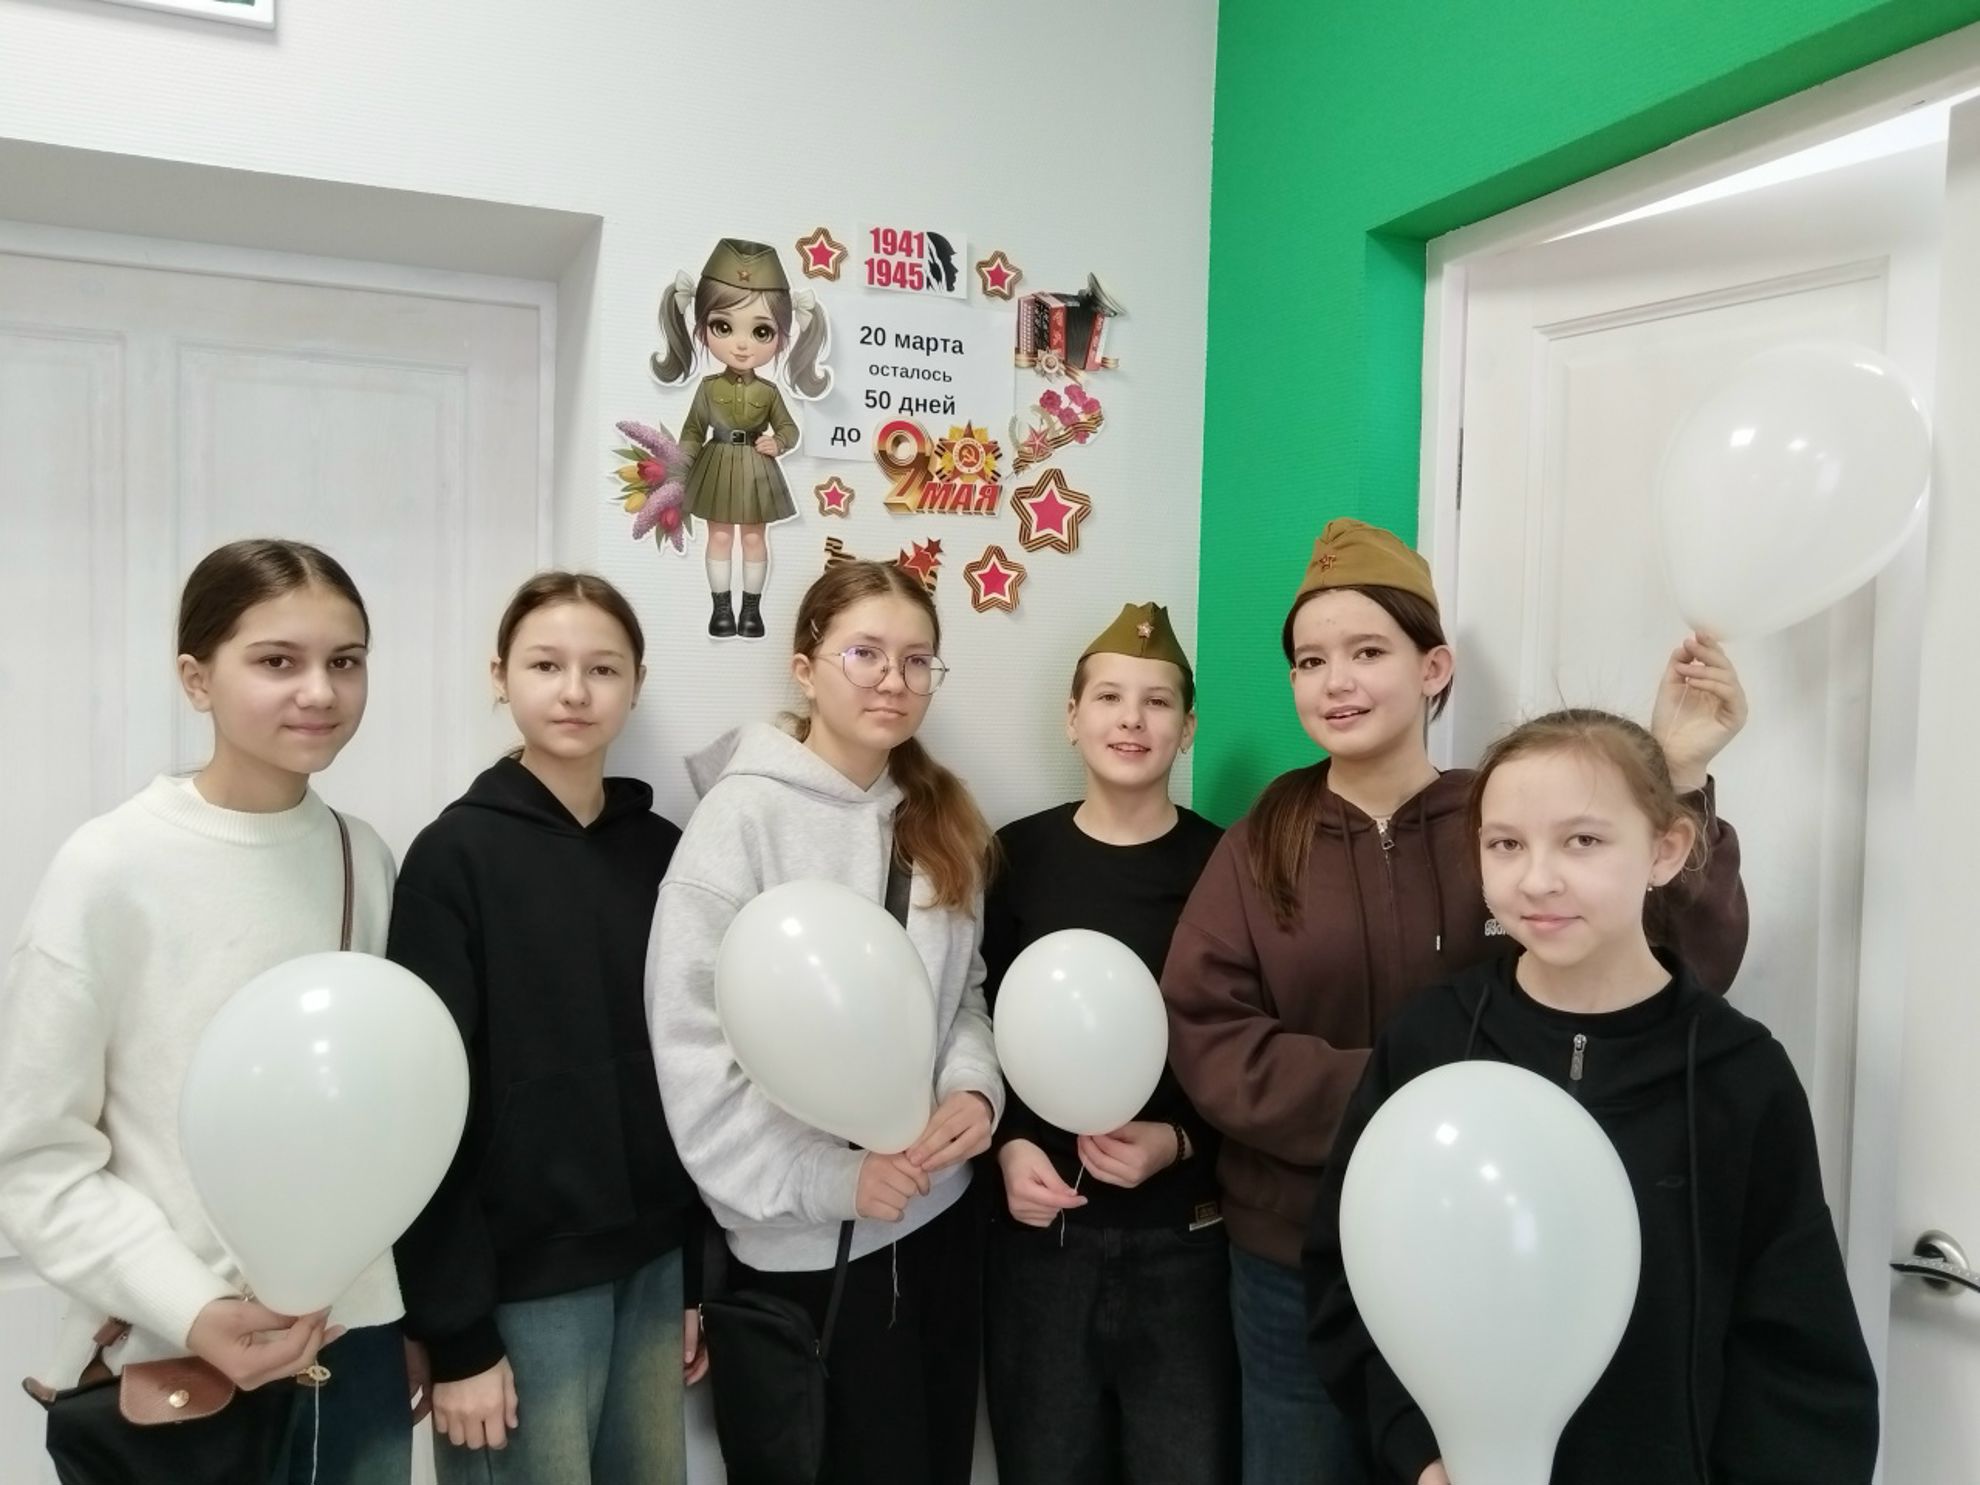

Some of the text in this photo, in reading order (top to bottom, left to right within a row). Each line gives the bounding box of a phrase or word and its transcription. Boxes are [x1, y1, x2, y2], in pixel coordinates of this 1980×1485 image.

[869, 227, 925, 259] 1941
[864, 257, 924, 291] 1945
[859, 326, 964, 355] 20 марта
[868, 363, 952, 383] осталось
[864, 389, 956, 415] 50 дней
[831, 426, 861, 447] до
[874, 417, 934, 514] 9
[917, 481, 1002, 514] МАЯ
